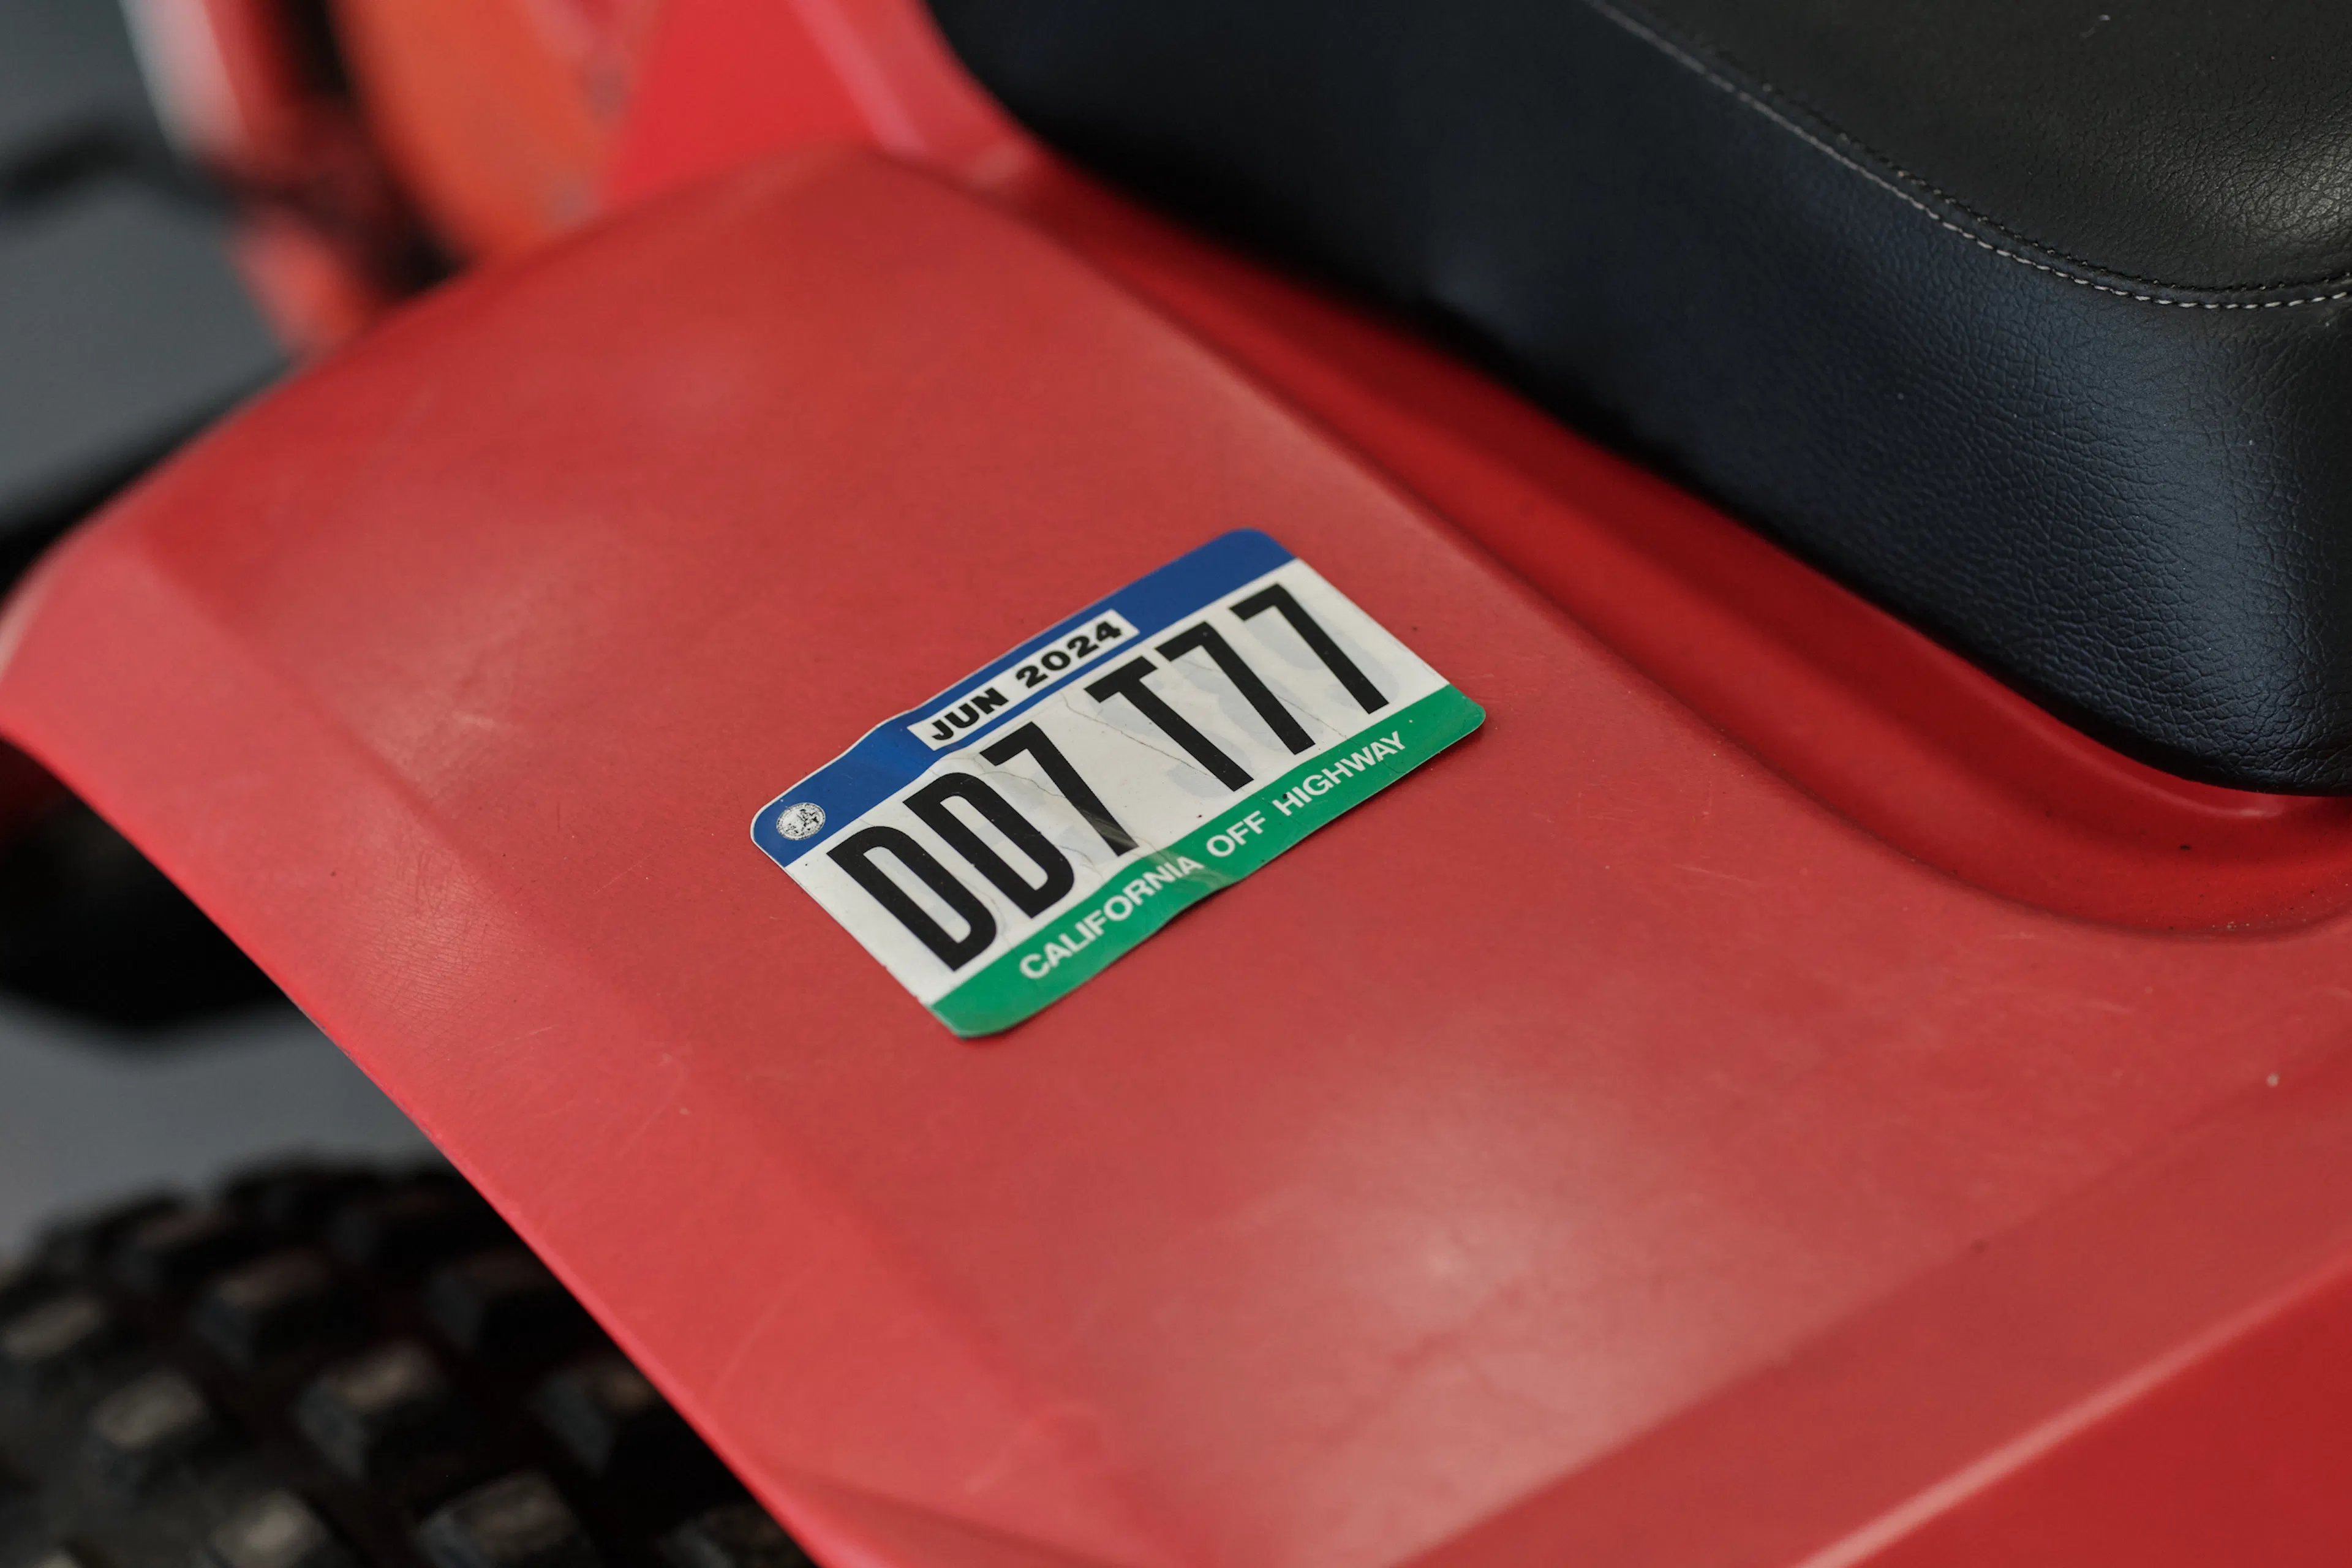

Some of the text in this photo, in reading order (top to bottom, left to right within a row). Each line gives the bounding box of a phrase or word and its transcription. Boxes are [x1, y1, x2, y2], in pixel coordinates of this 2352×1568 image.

[827, 582, 1389, 971] DD7 T77
[931, 620, 1123, 741] JUN 2024
[1020, 731, 1406, 979] CALIFORNIA OFF HIGHWAY
